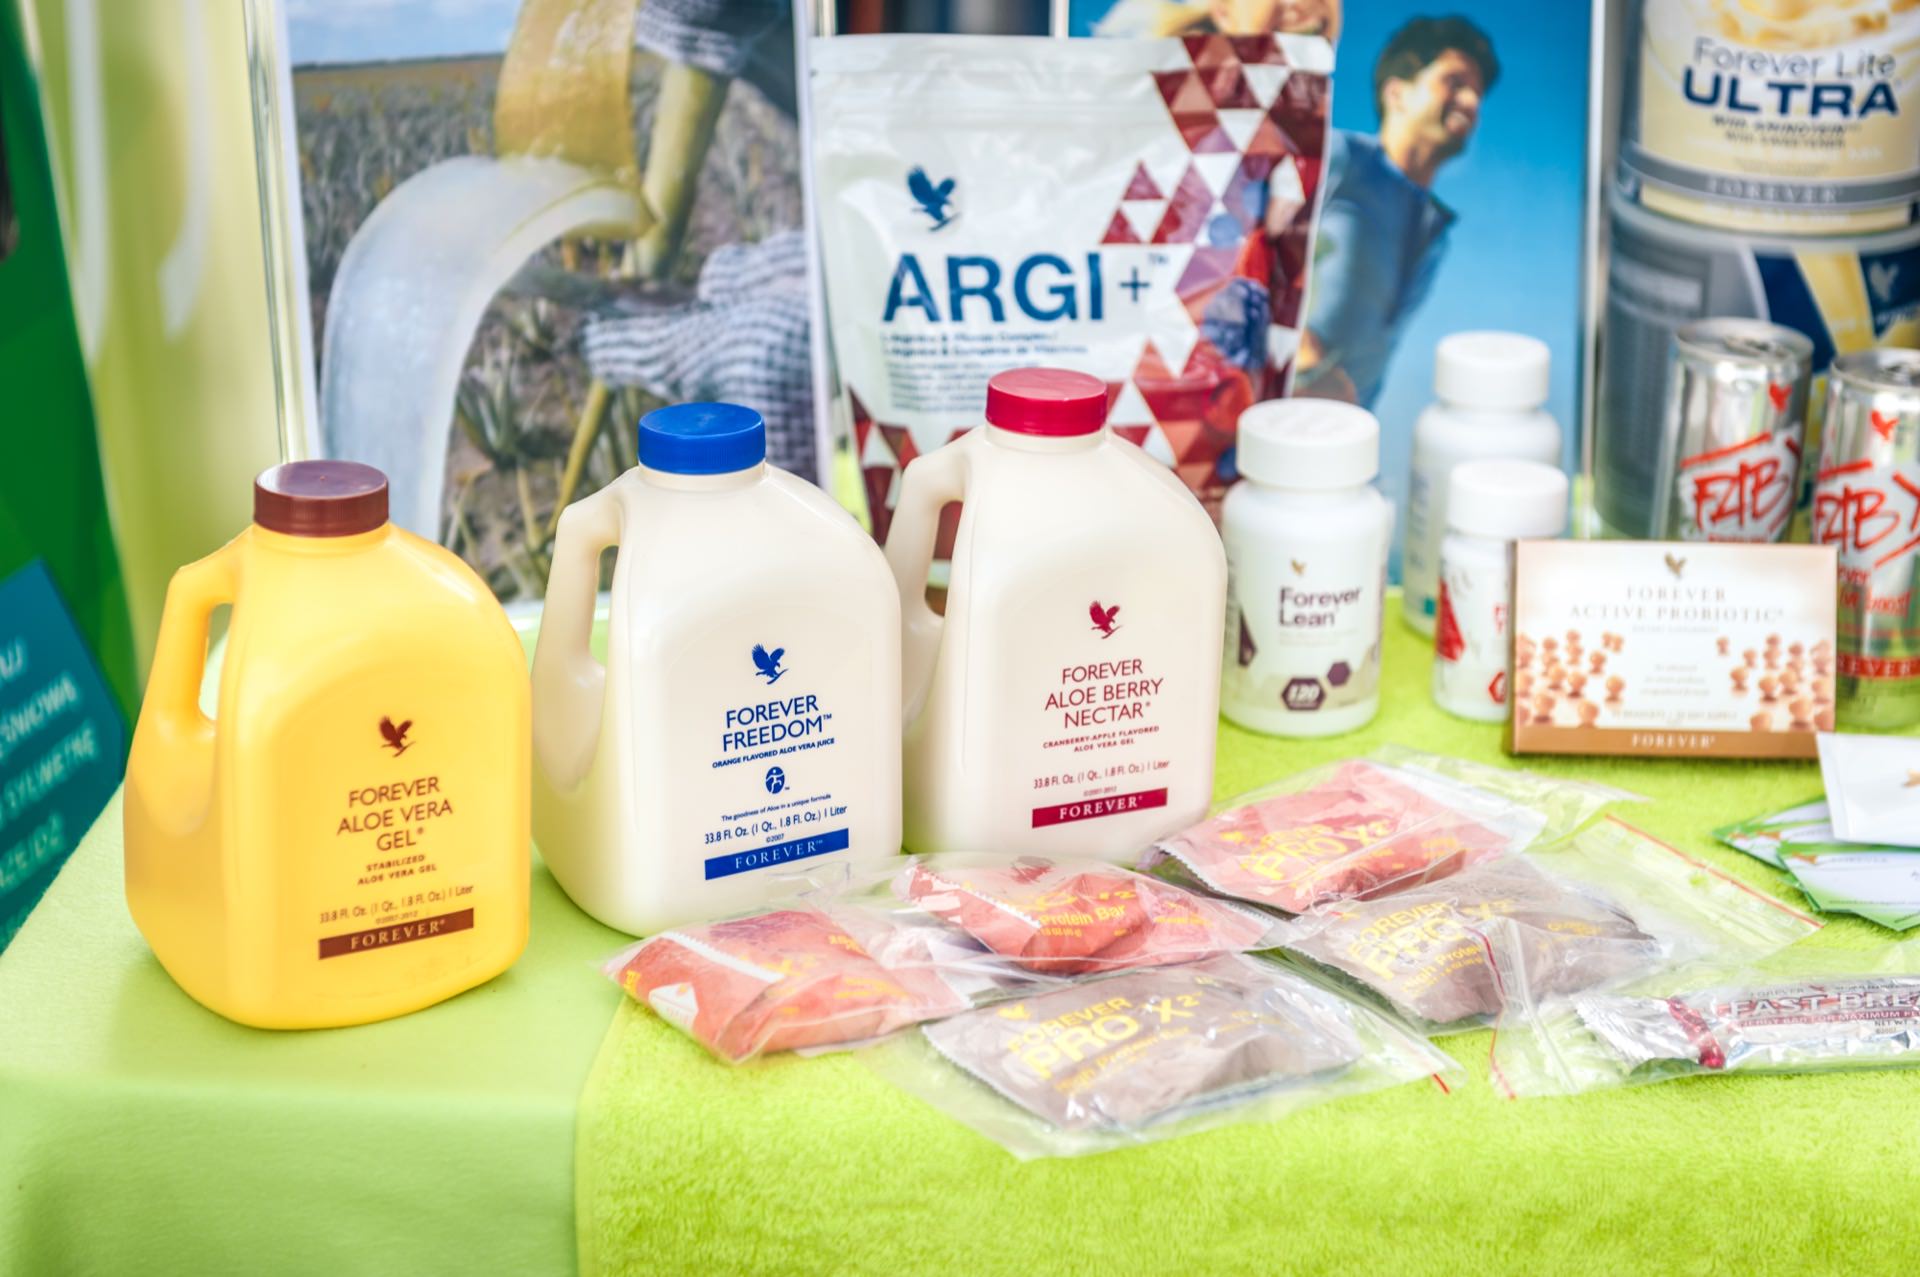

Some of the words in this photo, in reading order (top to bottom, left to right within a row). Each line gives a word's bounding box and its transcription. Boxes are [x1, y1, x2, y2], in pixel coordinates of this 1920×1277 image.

[1694, 36, 1826, 77] Forever
[1836, 51, 1897, 79] Lite
[1682, 66, 1899, 119] ULTRA
[1281, 586, 1361, 607] Forever
[1626, 586, 1726, 602] FOREVER
[1570, 604, 1648, 620] ACTIVE
[1061, 658, 1144, 685] FOREVER
[1044, 686, 1097, 712] ALOE
[1103, 676, 1164, 702] BERRY
[726, 694, 819, 729] FOREVER
[1073, 742, 1095, 753] ALOE
[1097, 739, 1118, 750] VERA
[1120, 737, 1135, 748] GEL
[1118, 725, 1160, 739] FLAVORED
[711, 756, 741, 769] ORANGE
[742, 749, 779, 763] FLAVORED
[780, 745, 797, 756] ALOE
[798, 741, 816, 752] VERA
[817, 737, 835, 749] JUICE
[1033, 776, 1050, 789] 33.8
[1153, 760, 1170, 771] Liter
[349, 776, 441, 808] FOREVER
[337, 809, 395, 836] ALOE
[399, 799, 454, 823] VERA
[721, 814, 733, 822] The
[733, 810, 759, 822] goodness
[767, 805, 780, 813] Aloe
[792, 799, 810, 809] unique
[811, 794, 832, 804] formula
[704, 832, 722, 845] 33.8
[780, 816, 791, 828] 1.8
[829, 805, 847, 817] Liter
[357, 873, 385, 886] ALOE
[389, 868, 414, 880] VERA
[418, 863, 437, 875] GEL
[366, 854, 426, 872] STABILIZED
[455, 885, 474, 897] Liter
[1095, 904, 1126, 921] Bar
[1727, 993, 1829, 1019] FAST
[1838, 1009, 1901, 1022] MAXIMUM
[1007, 996, 1133, 1054] FOREVER
[1020, 1013, 1140, 1081] PRO
